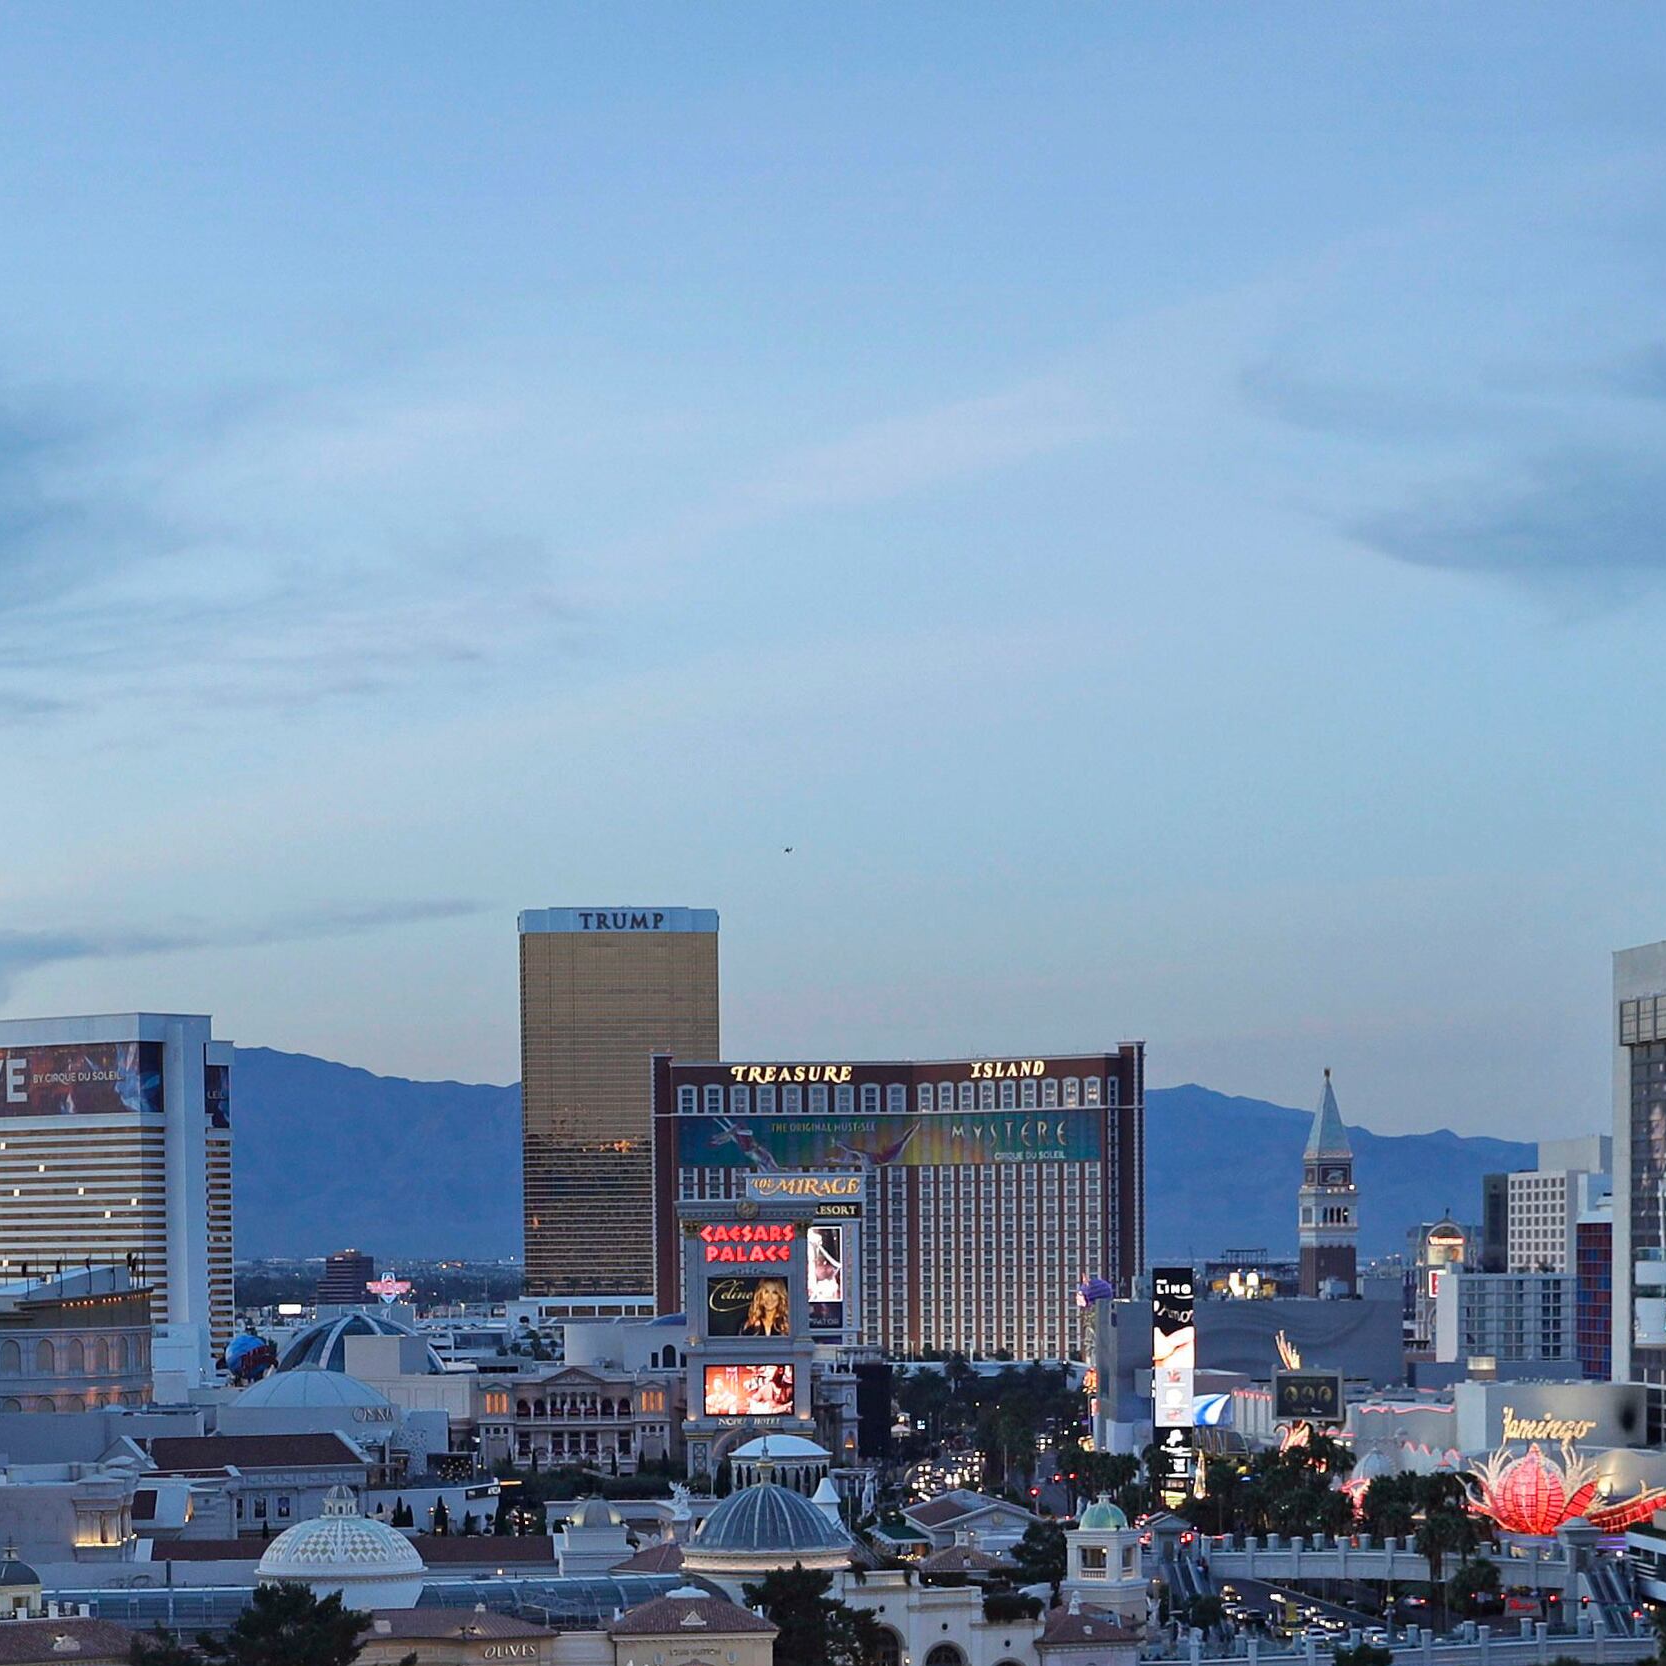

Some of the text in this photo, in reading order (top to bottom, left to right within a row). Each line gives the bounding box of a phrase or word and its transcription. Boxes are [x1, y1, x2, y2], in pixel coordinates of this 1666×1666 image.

[578, 912, 664, 930] TRUMP
[33, 1074, 44, 1084] BY
[45, 1072, 76, 1085] CIRQUE
[78, 1071, 90, 1082] DU
[92, 1070, 122, 1082] SOLEIL
[730, 1060, 1046, 1084] TREASURE ISLAND
[771, 1122, 787, 1133] THE
[789, 1122, 832, 1132] ORIGINAL
[1025, 1151, 1037, 1160] DU
[1038, 1150, 1066, 1160] SOLEIL
[776, 1177, 861, 1197] MIRAGE
[700, 1224, 795, 1243] CAESARS
[705, 1245, 791, 1262] PALACE
[484, 1644, 536, 1660] OLIVES
